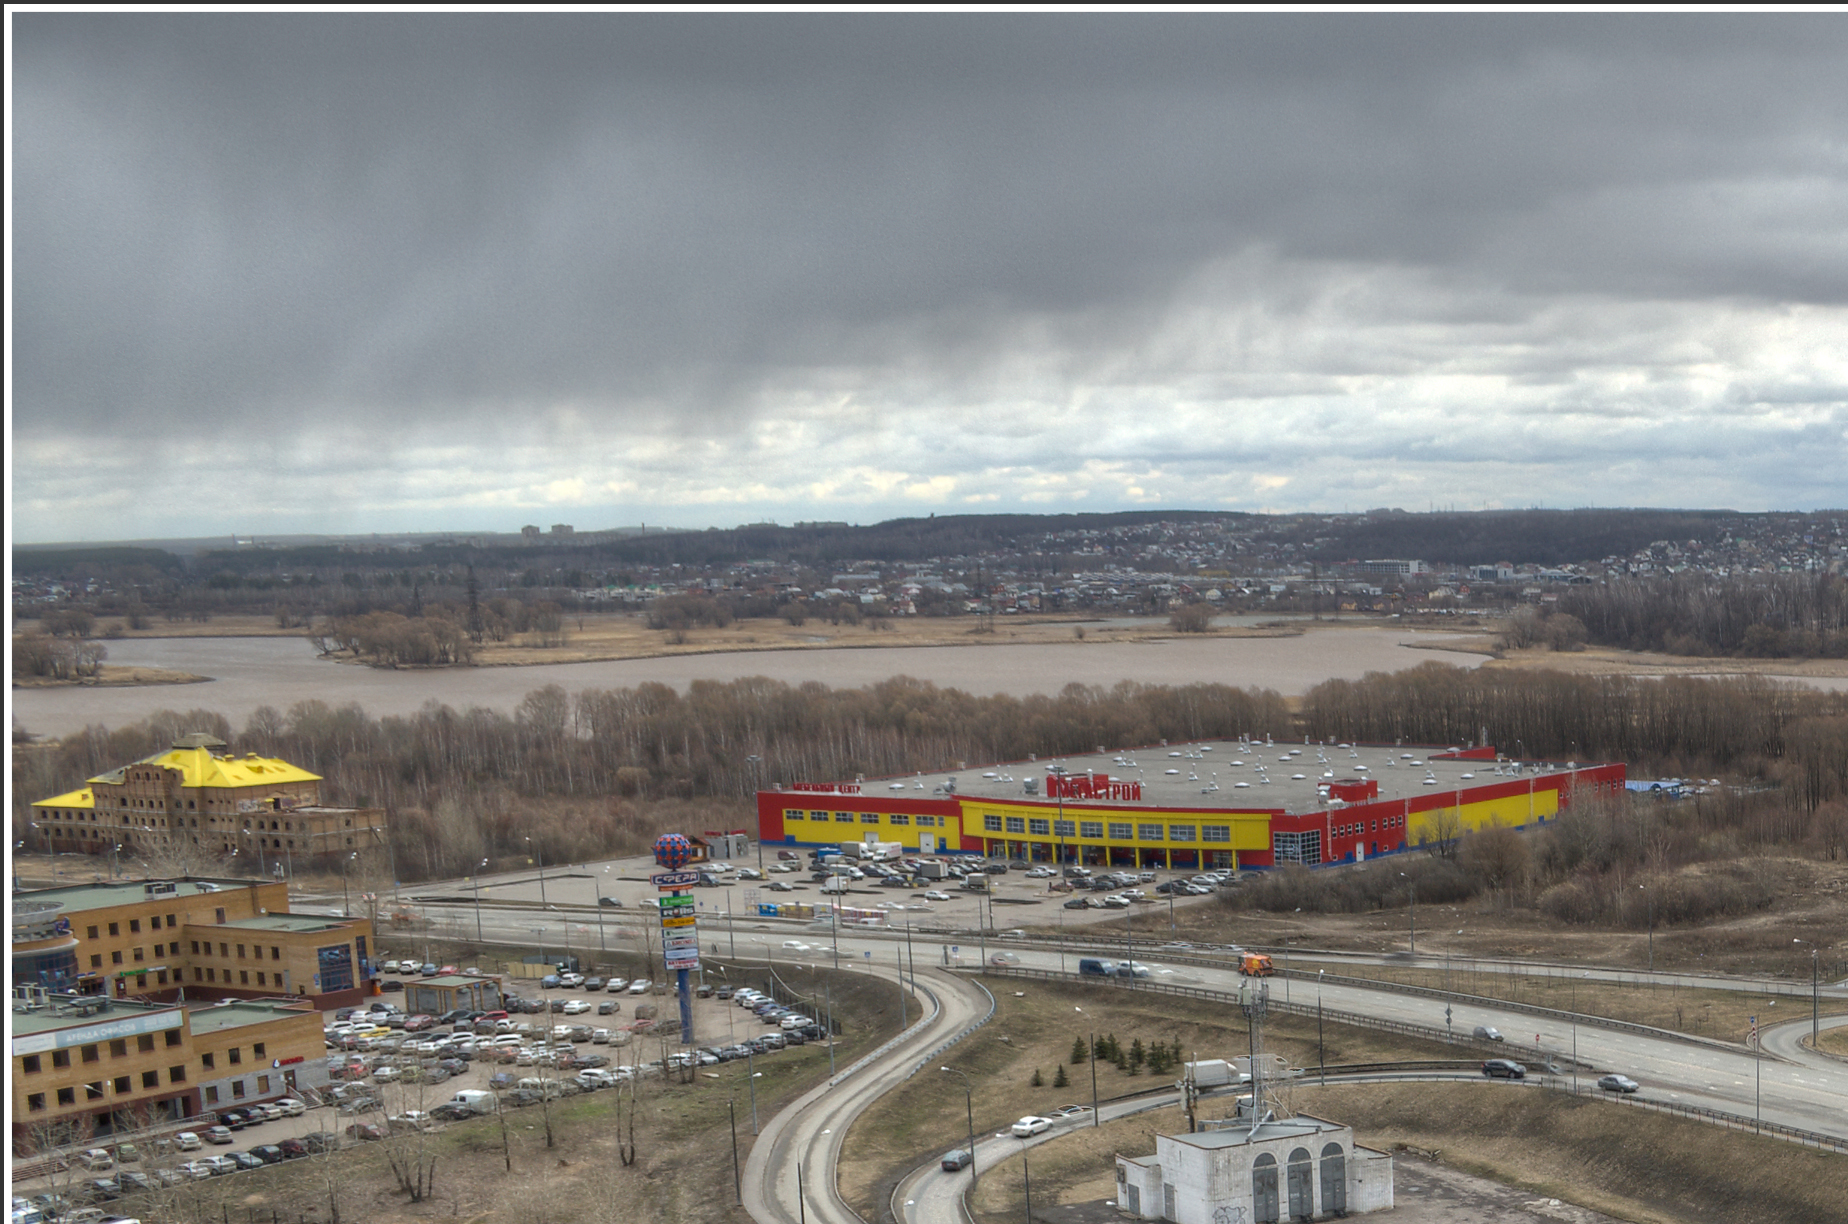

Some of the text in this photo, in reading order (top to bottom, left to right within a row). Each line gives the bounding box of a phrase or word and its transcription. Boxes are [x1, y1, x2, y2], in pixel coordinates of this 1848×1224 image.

[655, 873, 697, 884] СФЕРА
[66, 1023, 137, 1042] АРЕНДА ОФИСОВ
